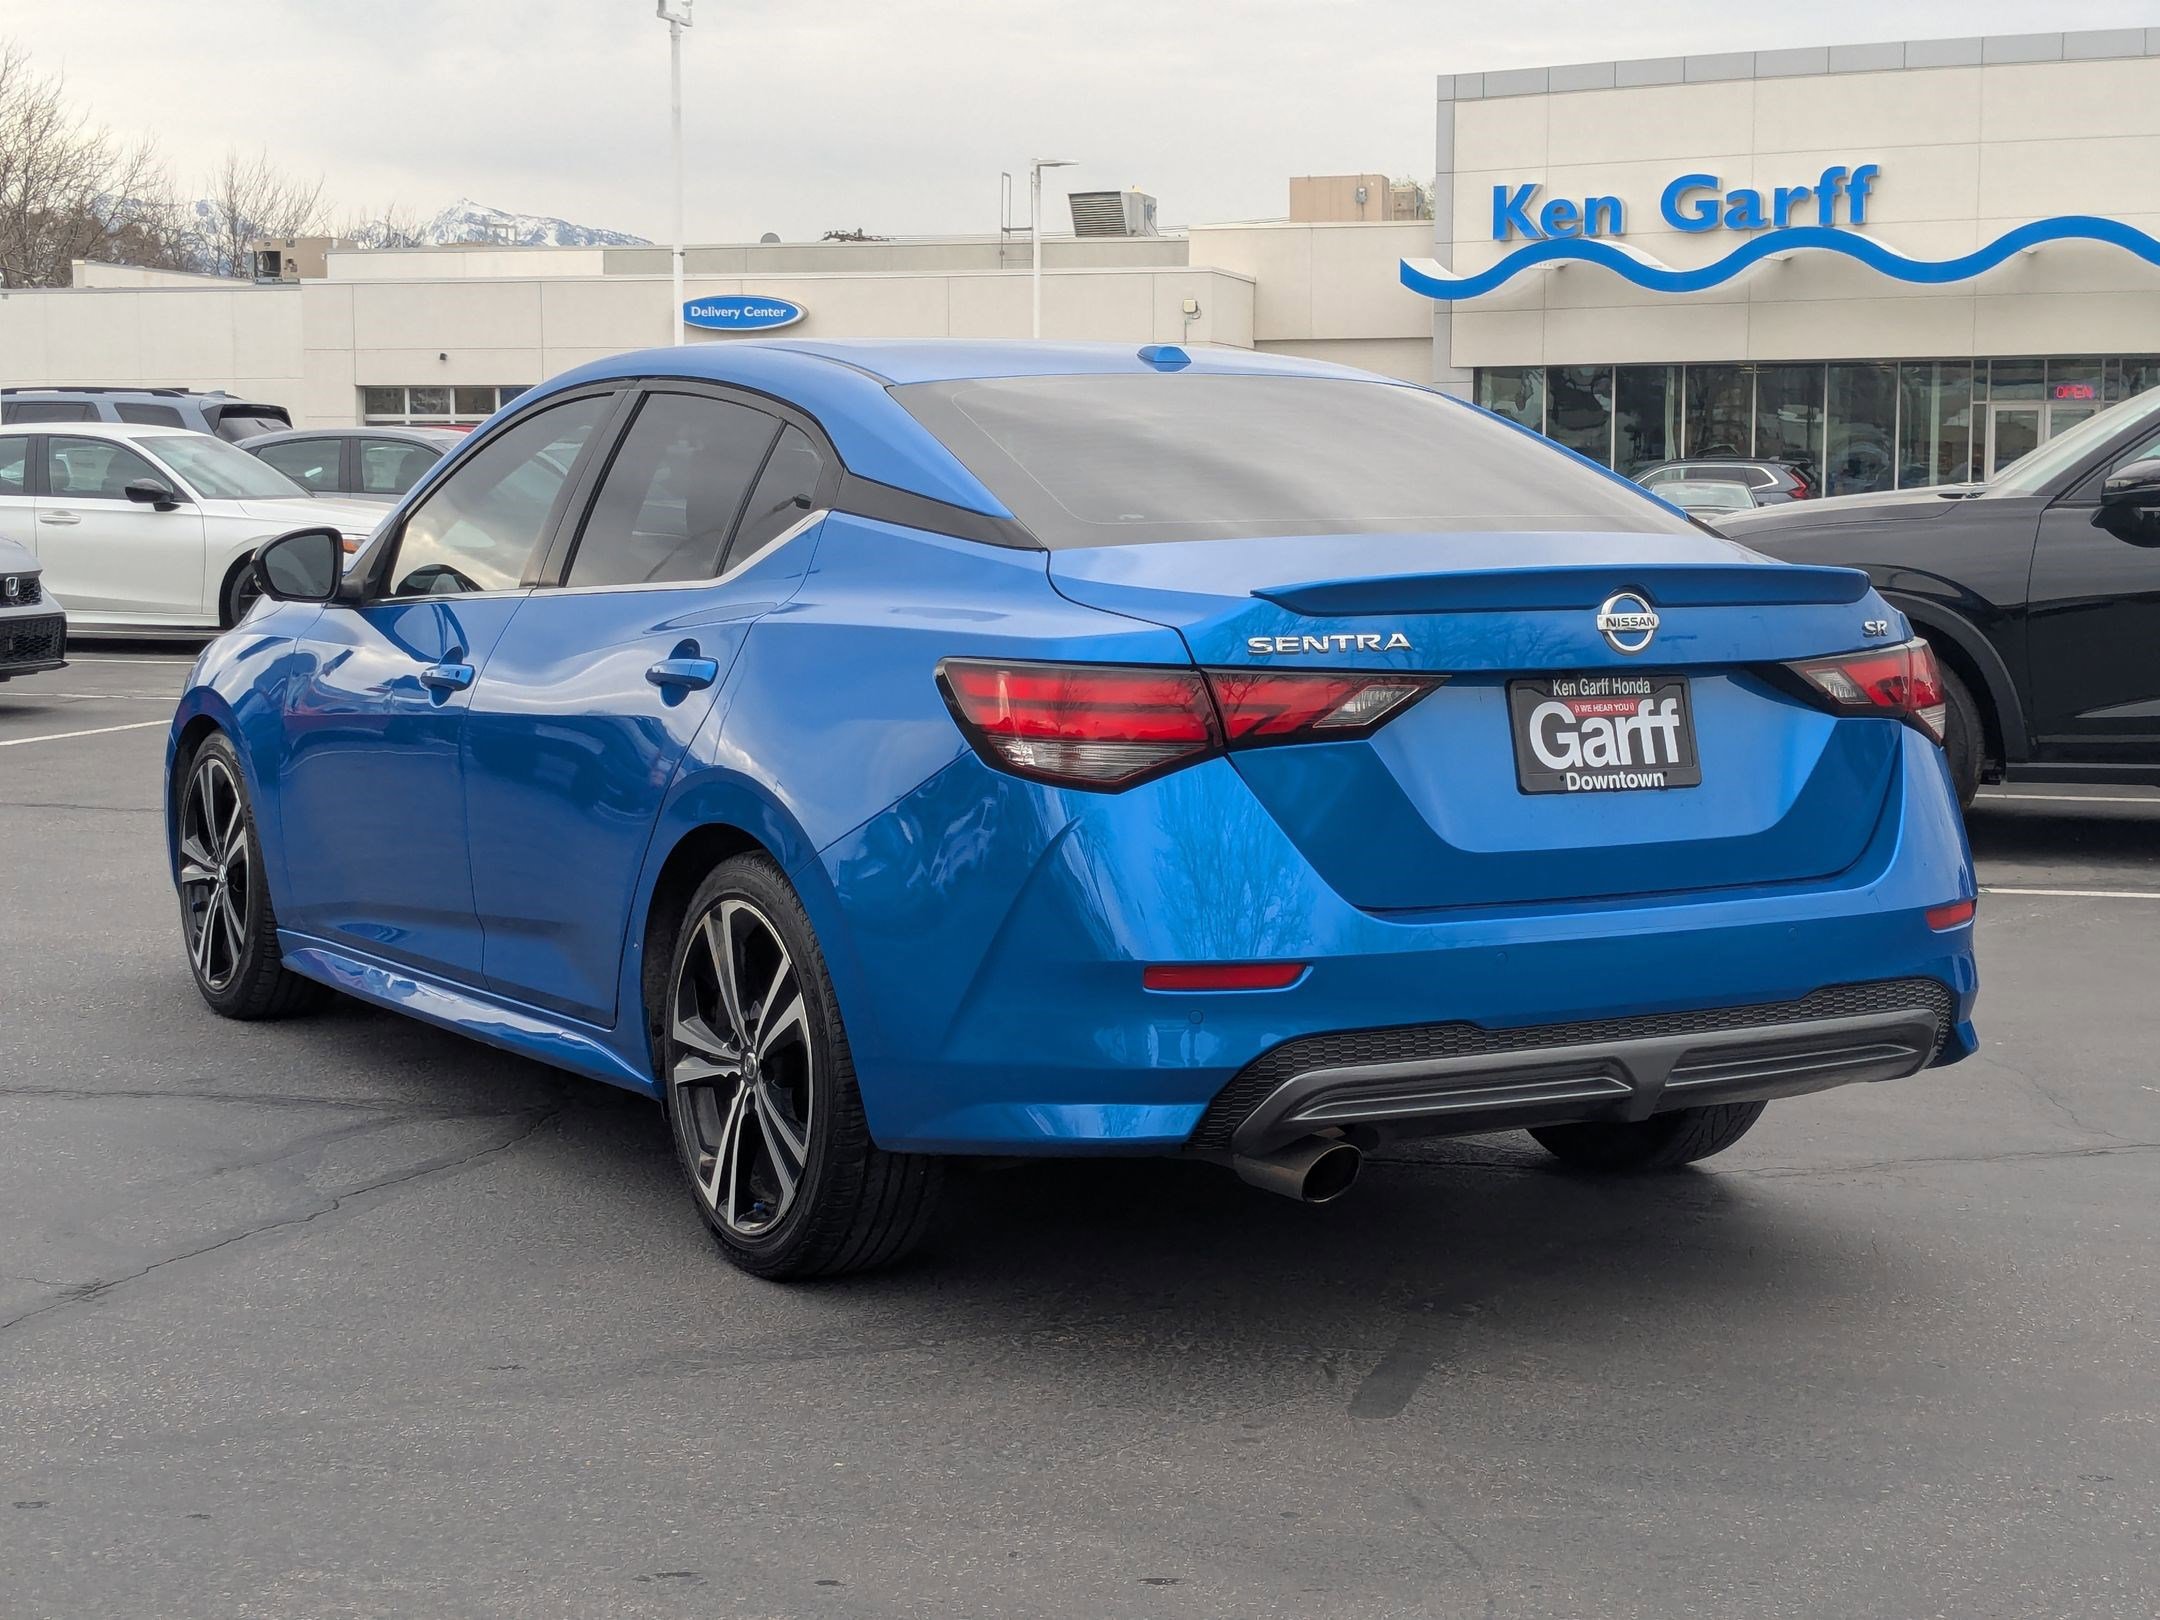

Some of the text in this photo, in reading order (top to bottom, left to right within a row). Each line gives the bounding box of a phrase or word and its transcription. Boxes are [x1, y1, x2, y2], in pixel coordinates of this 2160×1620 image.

[1492, 164, 1881, 240] Ken Garff
[690, 305, 787, 320] Delivery Center
[2056, 383, 2094, 400] OPEN
[1605, 616, 1655, 628] NISSAN
[1862, 620, 1889, 637] SR
[1247, 632, 1414, 655] SENTRA
[1552, 676, 1652, 697] Ken Garff Honda
[1580, 702, 1630, 713] WE HEAR YOU
[1529, 697, 1681, 770] Garff
[1565, 770, 1665, 792] Downtown
